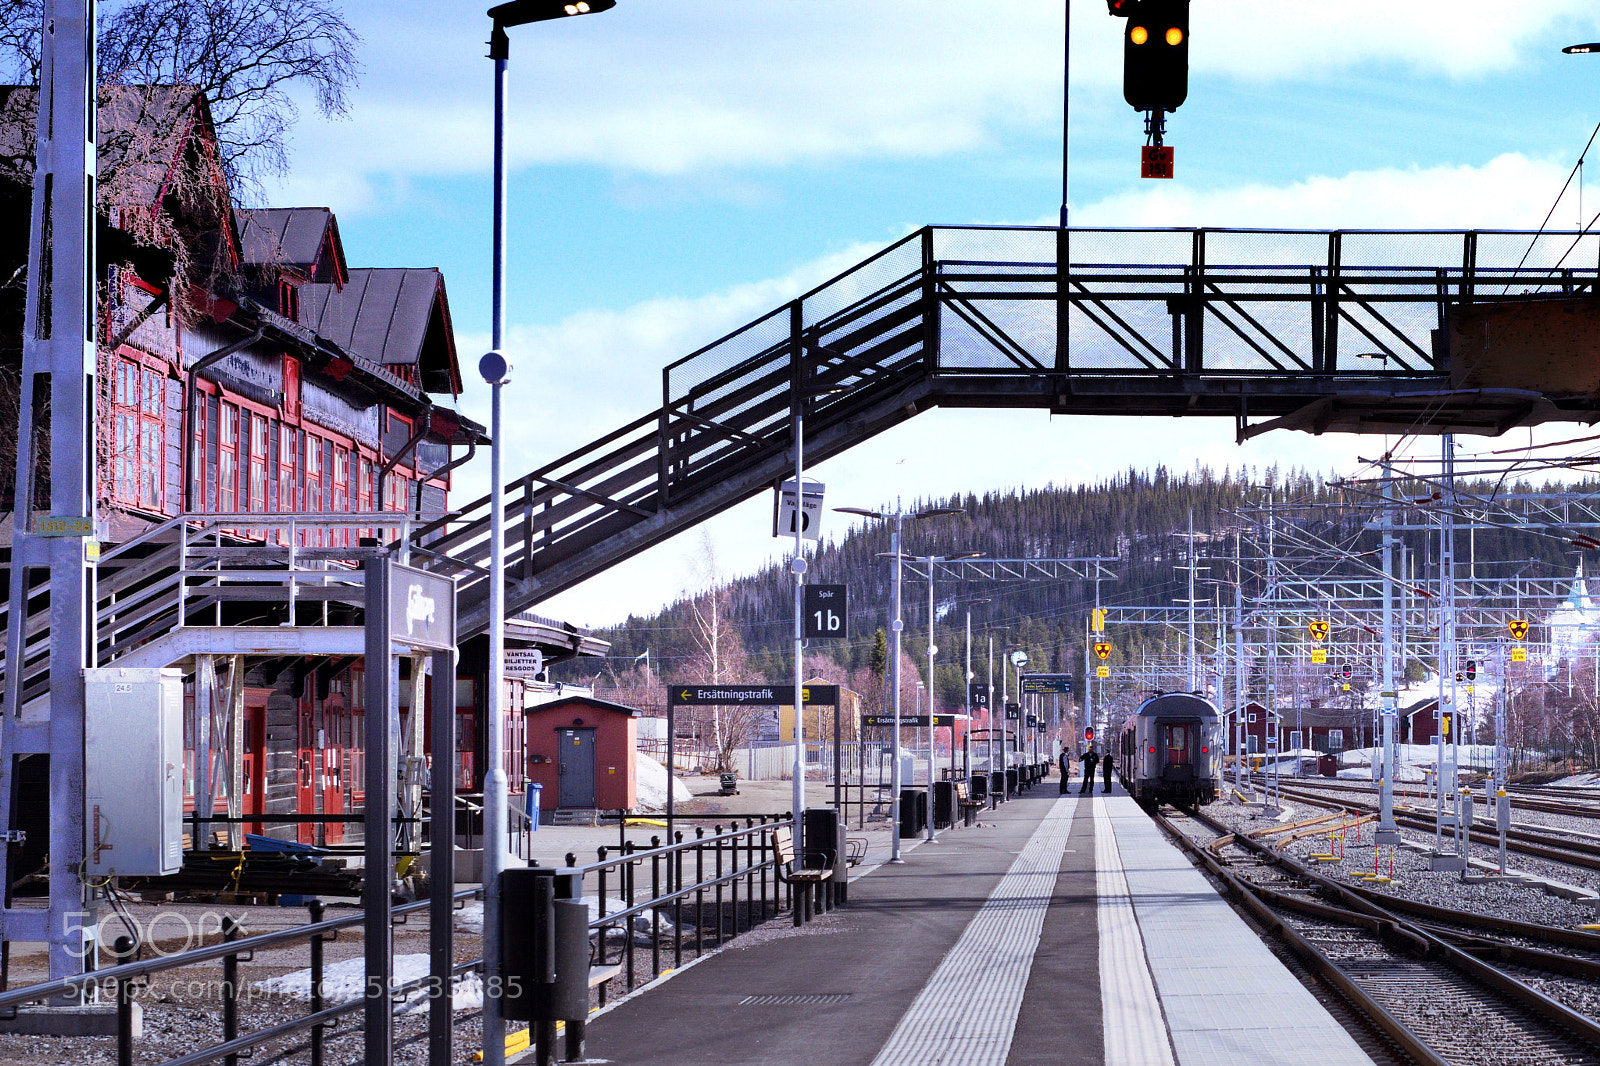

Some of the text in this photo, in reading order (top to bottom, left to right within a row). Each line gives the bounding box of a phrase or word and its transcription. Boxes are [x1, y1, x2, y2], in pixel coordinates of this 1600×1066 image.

[818, 590, 835, 600] Spår
[813, 609, 841, 631] 1b
[697, 689, 774, 701] Ersättningstrafik
[974, 693, 986, 703] 1a
[877, 717, 919, 725] Ersättngstrafik
